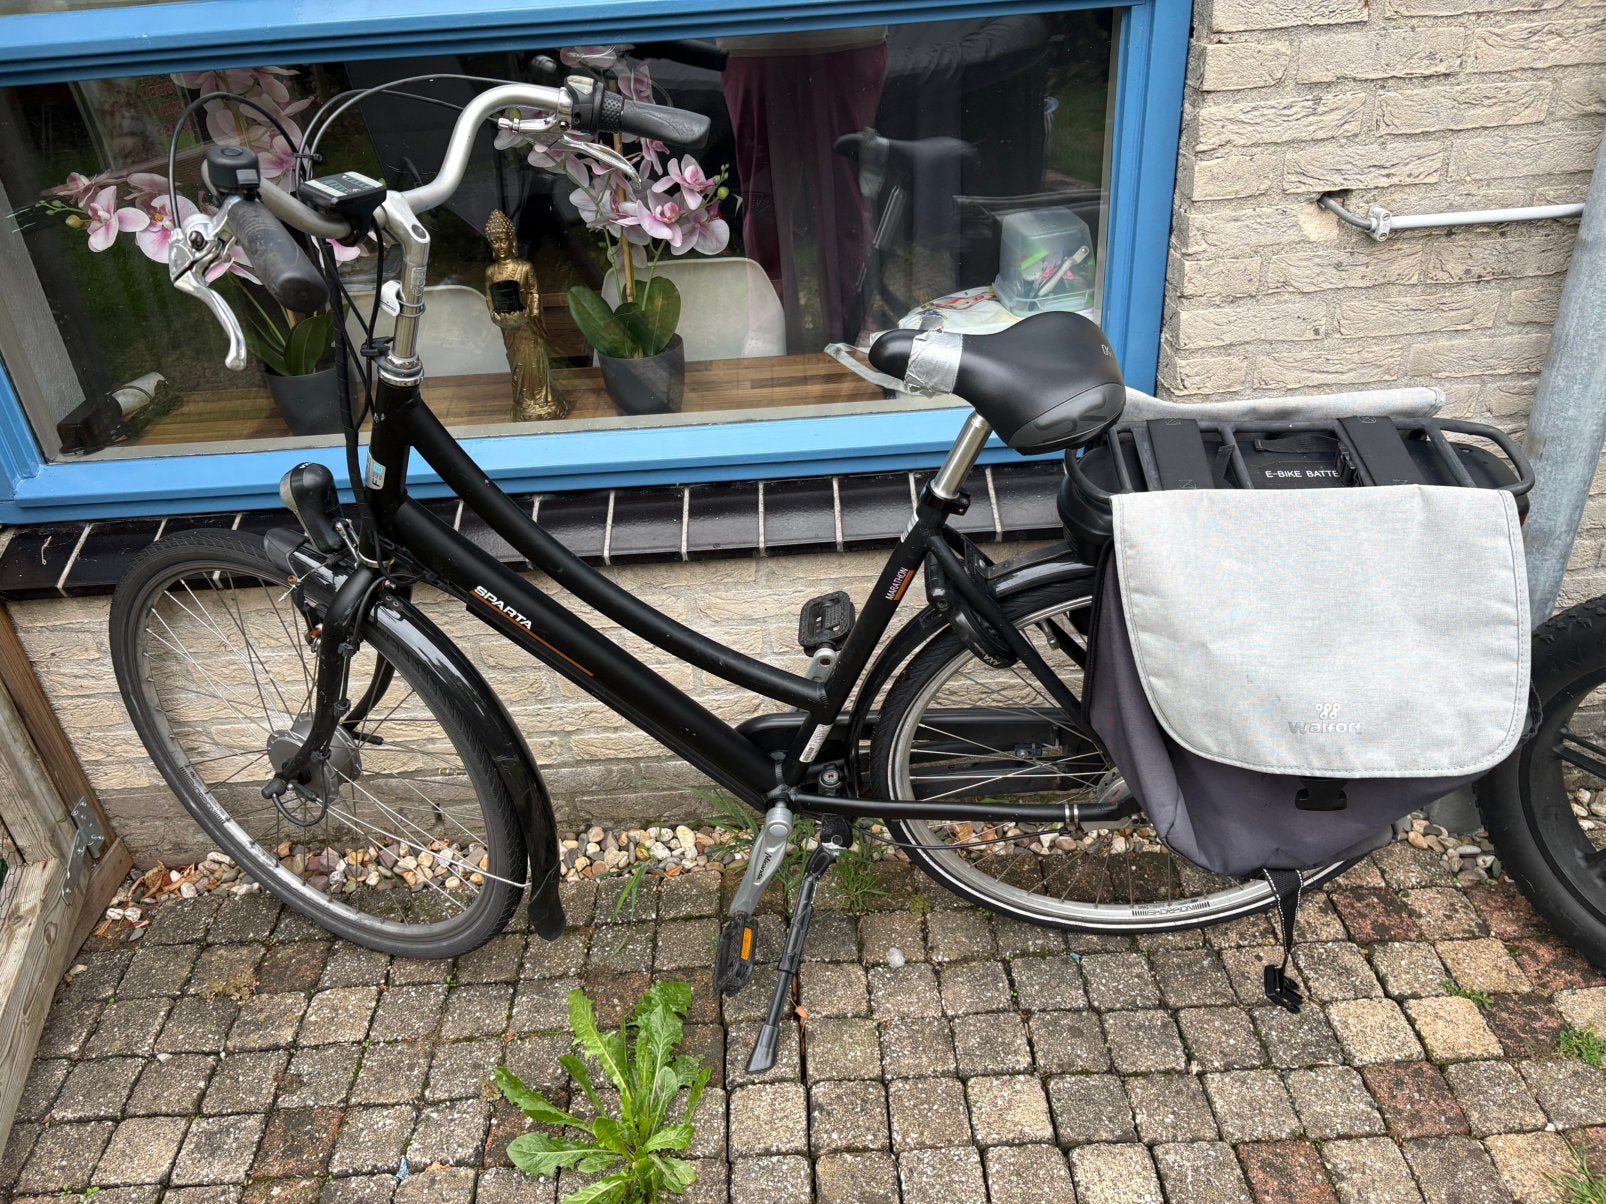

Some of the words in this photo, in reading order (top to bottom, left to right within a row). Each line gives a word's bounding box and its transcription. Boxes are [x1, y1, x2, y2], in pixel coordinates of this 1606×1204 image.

[1265, 470, 1303, 478] E-BIKE
[1306, 470, 1341, 478] BATTE
[885, 566, 908, 600] MARATHON
[474, 585, 532, 630] SPARTA
